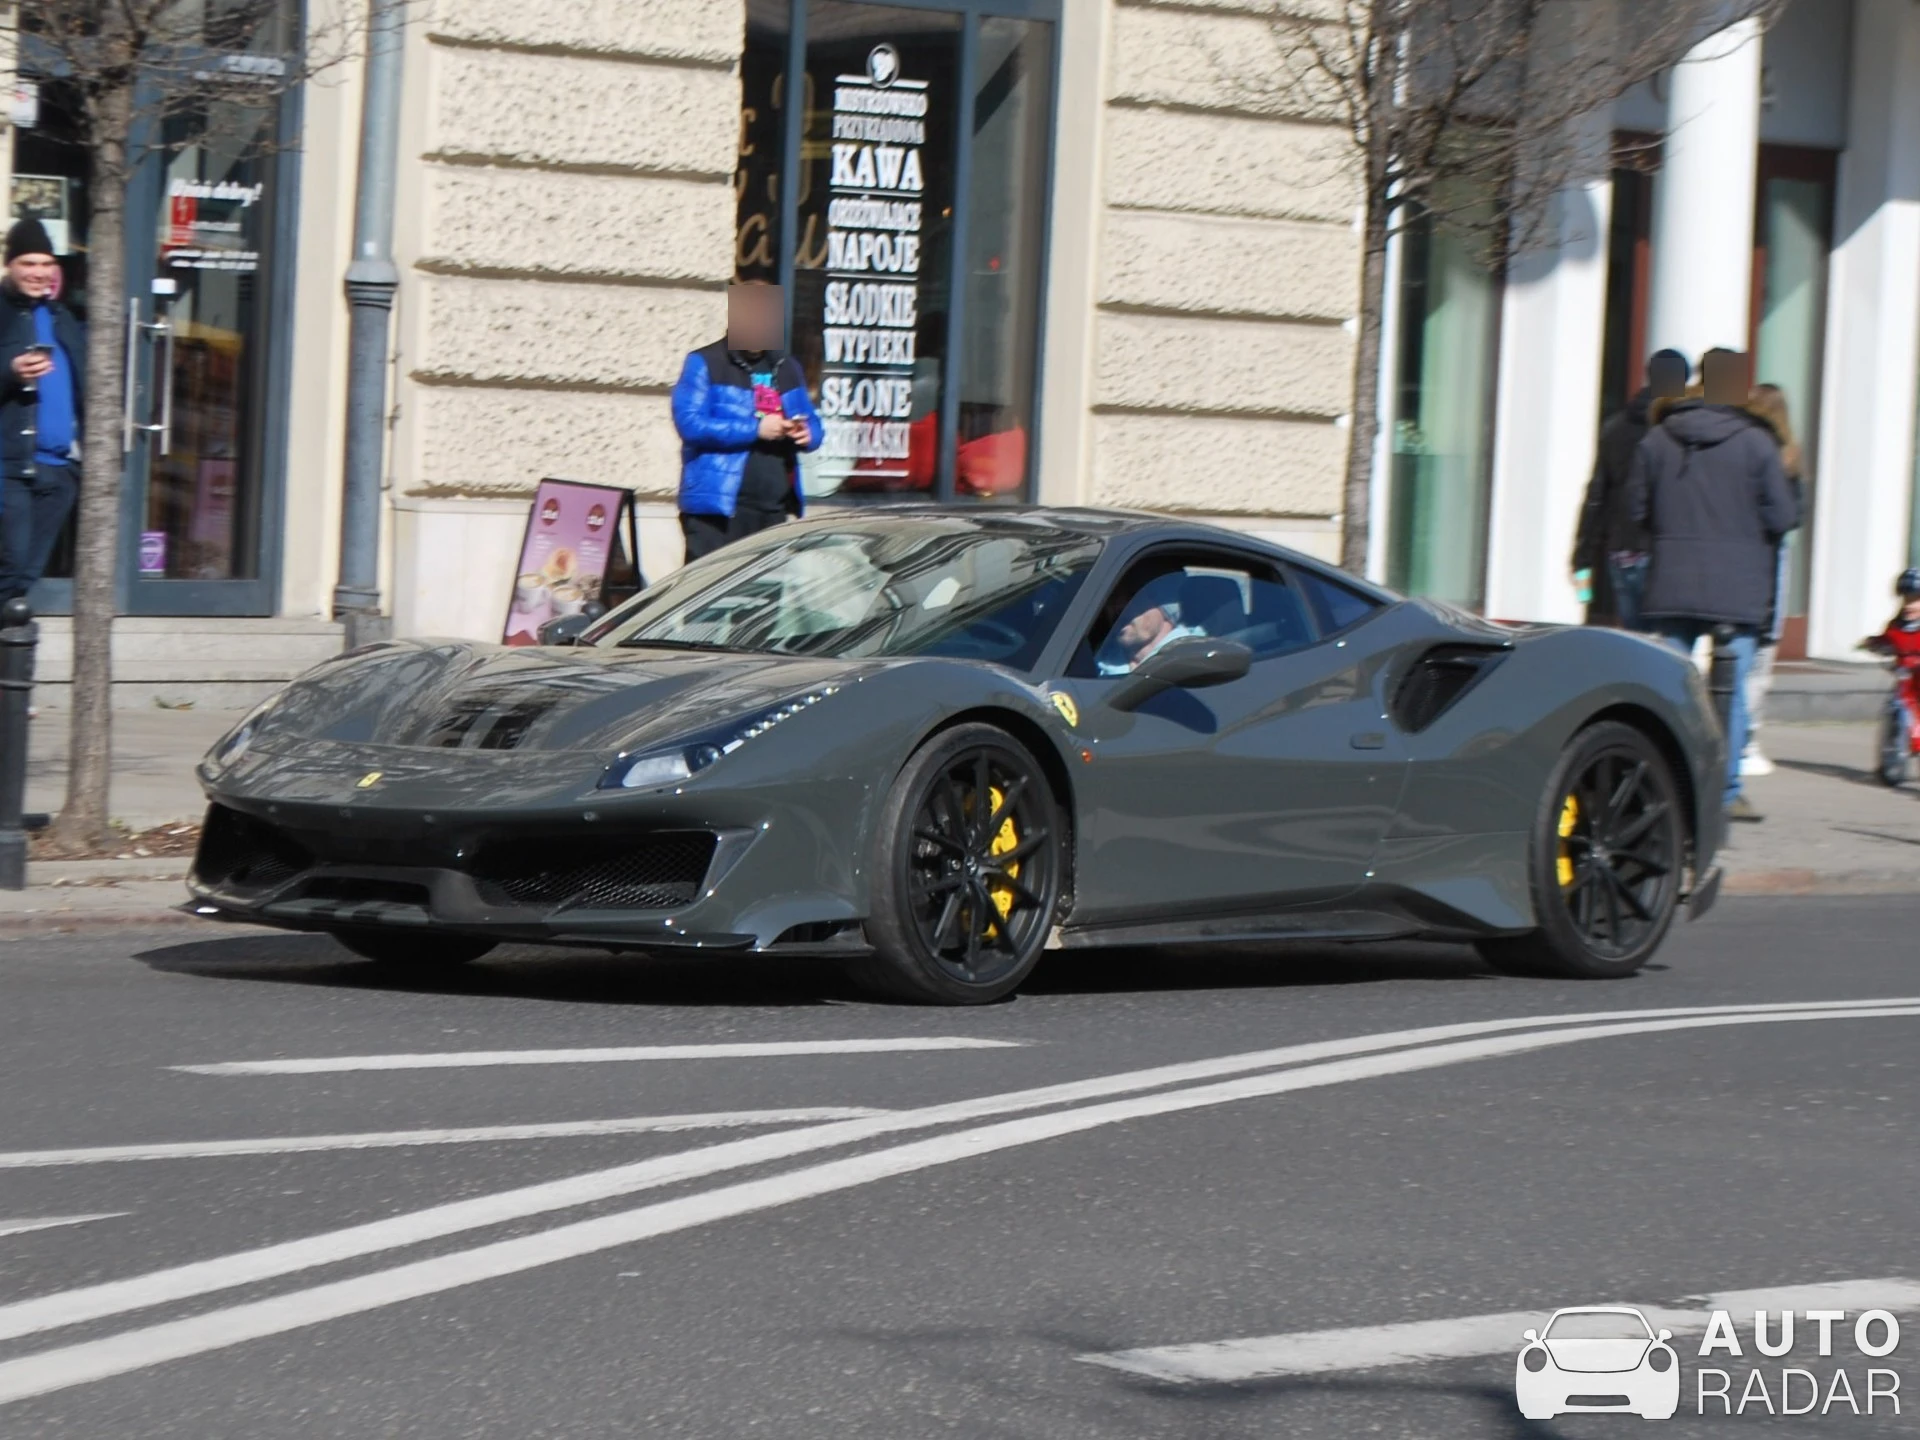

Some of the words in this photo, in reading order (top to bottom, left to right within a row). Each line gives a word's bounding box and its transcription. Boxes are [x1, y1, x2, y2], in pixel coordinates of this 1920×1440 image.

[829, 144, 924, 191] KAWA
[827, 231, 920, 273] NAPOJE
[823, 281, 917, 327] SŁODKIE
[822, 327, 917, 364] WYPIEKI
[821, 377, 912, 417] SŁONE
